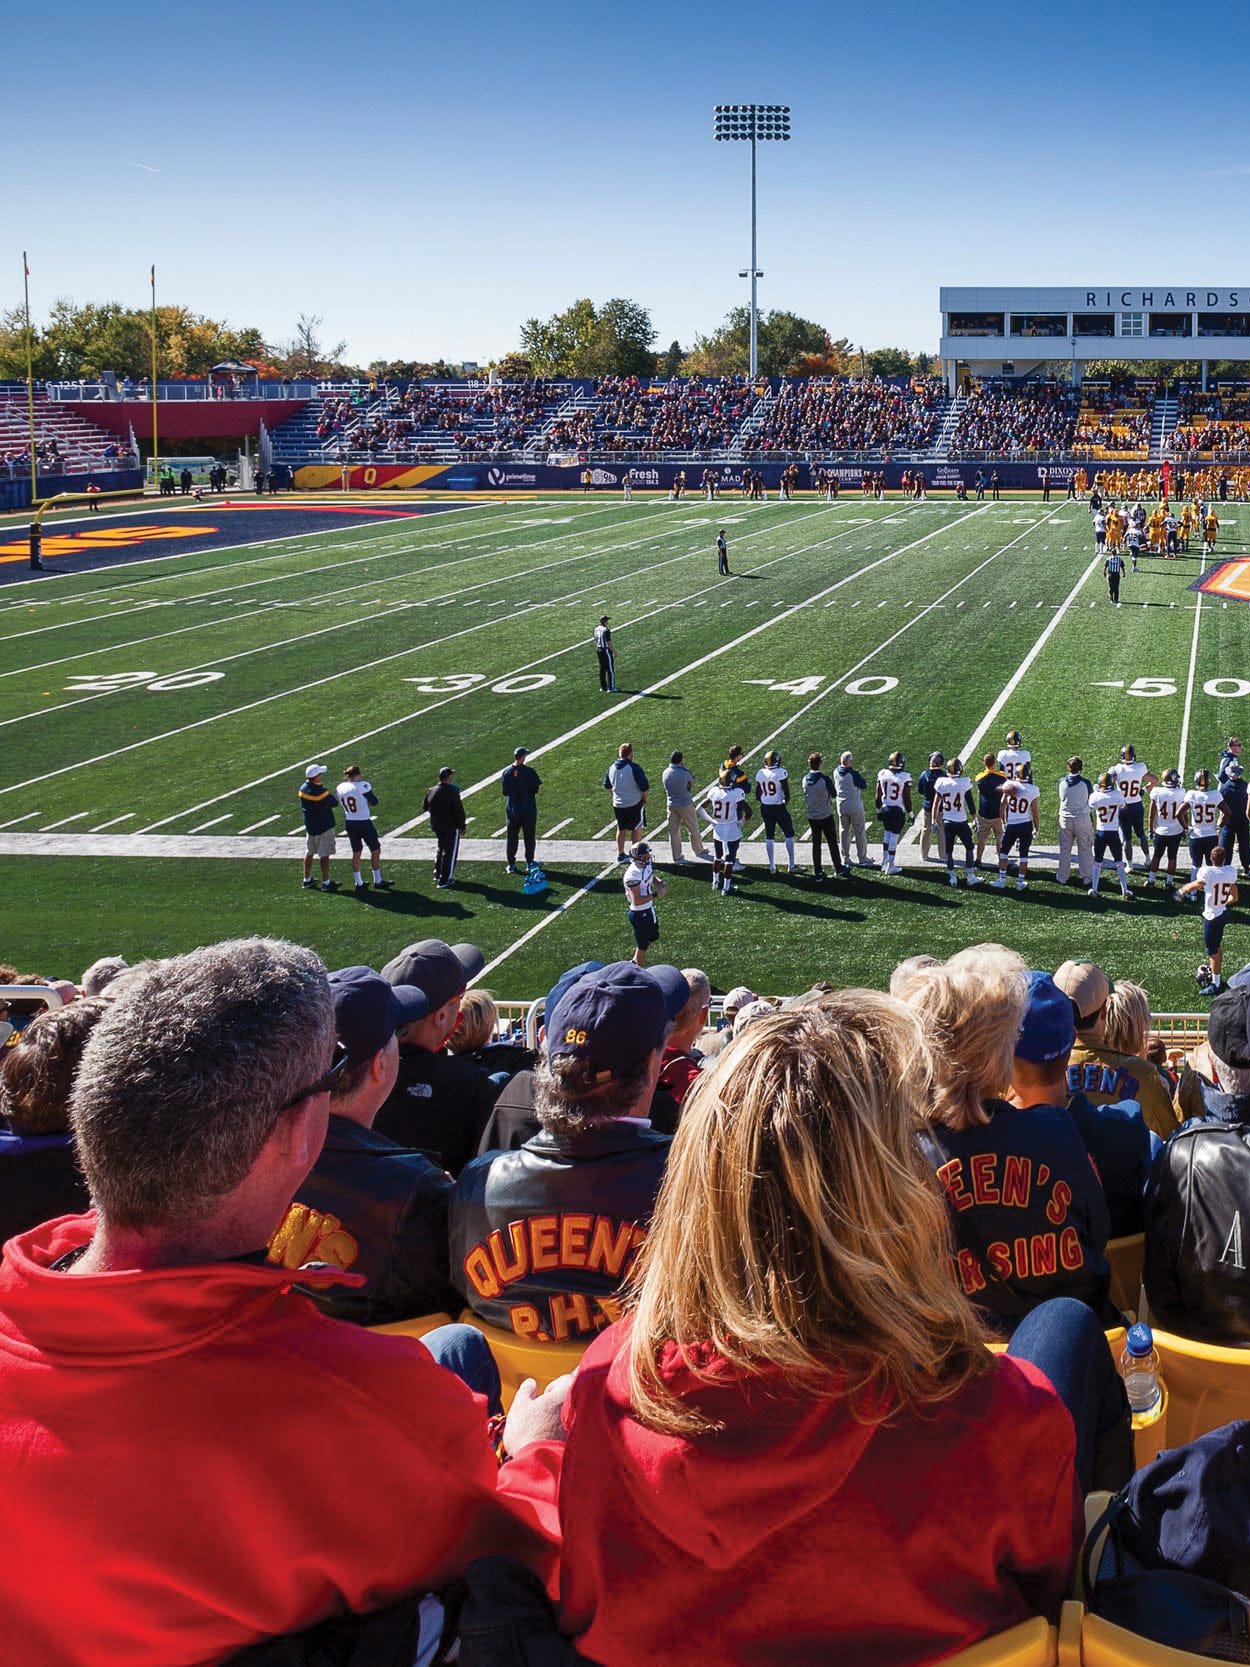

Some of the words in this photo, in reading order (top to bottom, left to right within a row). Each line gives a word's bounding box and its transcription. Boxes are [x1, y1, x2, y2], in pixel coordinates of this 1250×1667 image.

[629, 468, 659, 479] Fresh
[416, 673, 557, 694] 30
[768, 676, 900, 695] 40
[761, 780, 777, 797] 19
[882, 781, 900, 801] 13
[1119, 779, 1140, 798] 96
[340, 796, 358, 813] 18
[713, 800, 731, 820] 21
[942, 792, 962, 812] 54
[1009, 794, 1029, 814] 90
[1159, 801, 1177, 820] 41
[1097, 804, 1118, 823] 27
[1194, 803, 1216, 824] 35
[565, 1029, 587, 1045] 86
